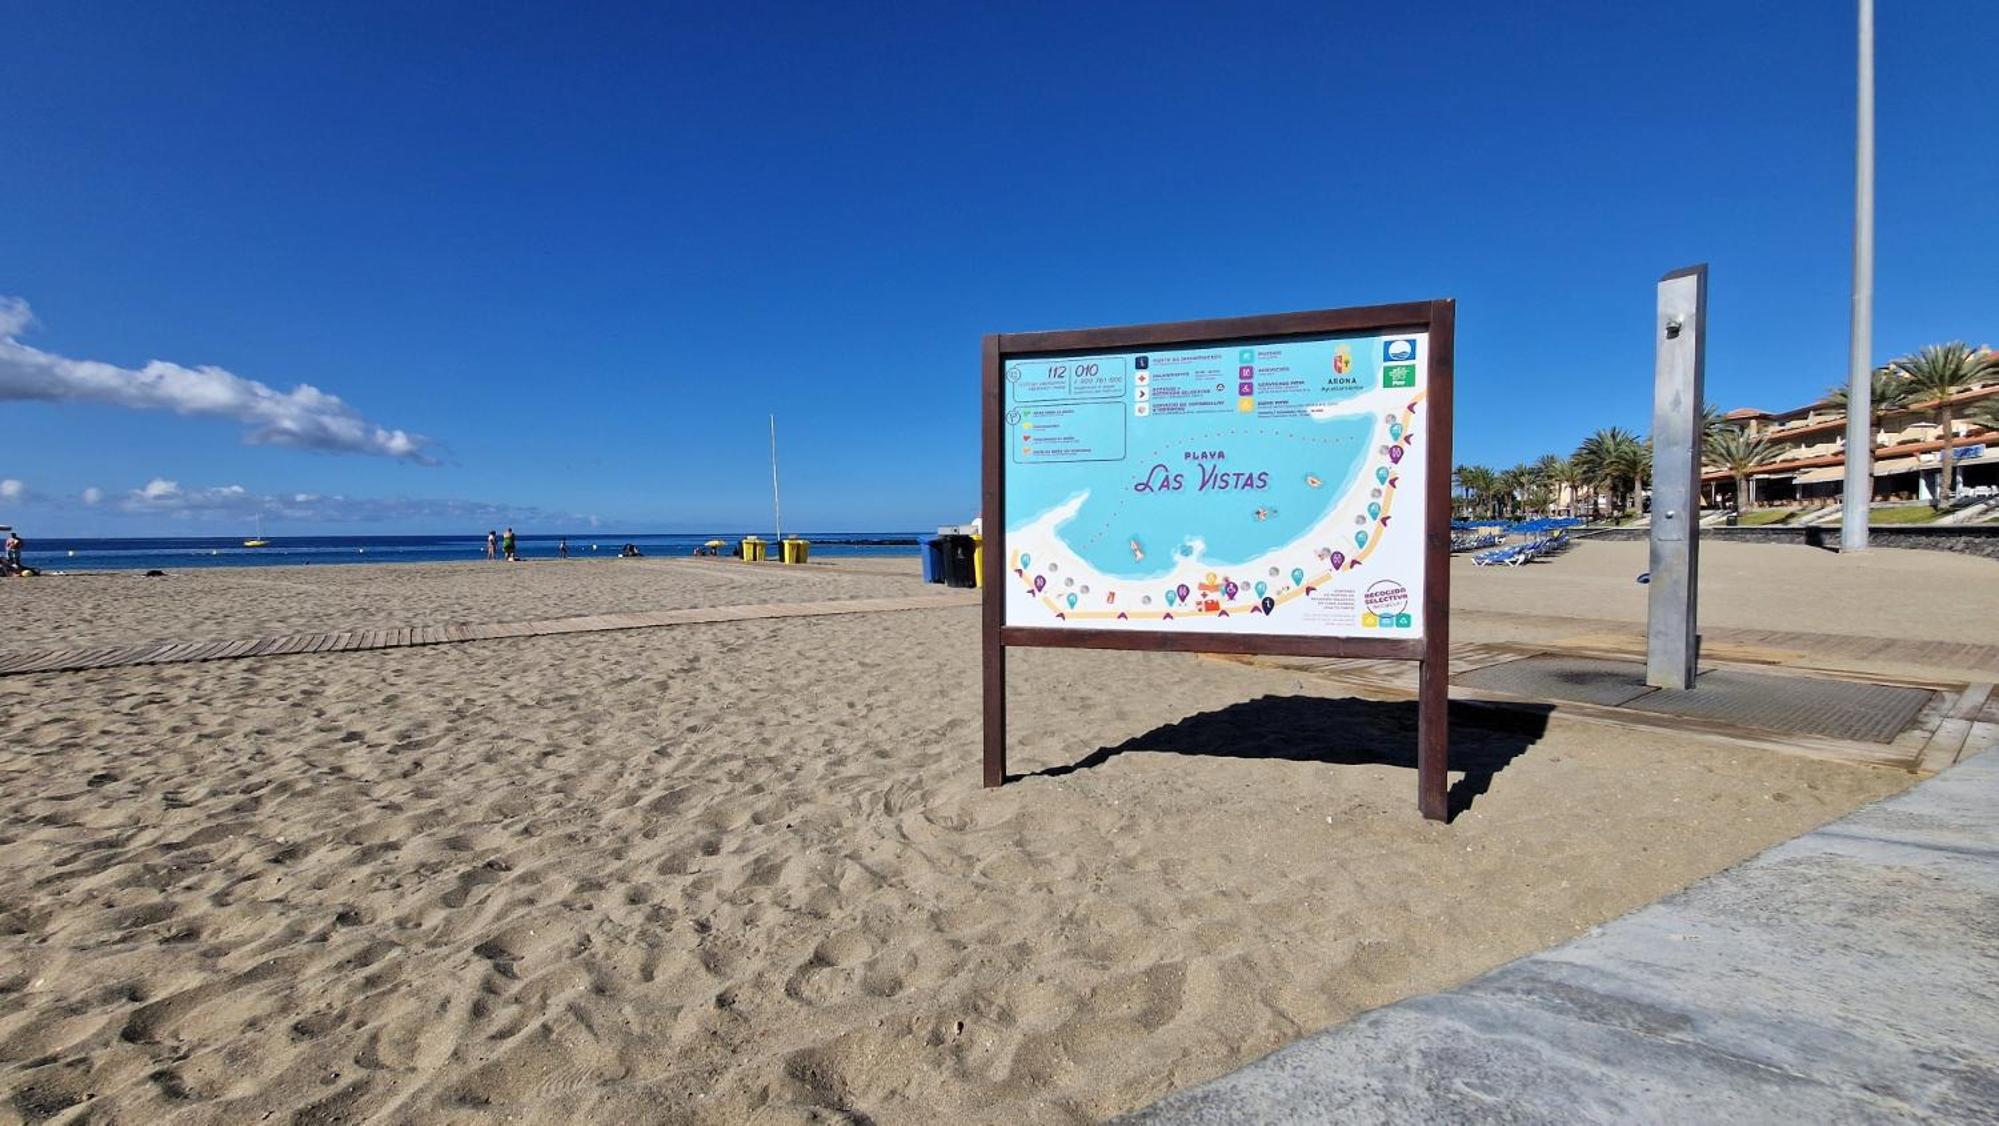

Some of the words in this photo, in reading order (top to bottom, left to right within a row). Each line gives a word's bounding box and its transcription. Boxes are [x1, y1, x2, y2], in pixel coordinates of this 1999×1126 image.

[1047, 366, 1067, 379] 112
[1074, 363, 1099, 378] 010
[1327, 377, 1357, 385] ARONA
[1184, 450, 1225, 460] PLAYA
[1134, 463, 1184, 493] LAS
[1198, 463, 1269, 491] VISTAS
[1364, 587, 1406, 598] RECOGIDA
[1365, 594, 1408, 605] SELECTIVA
